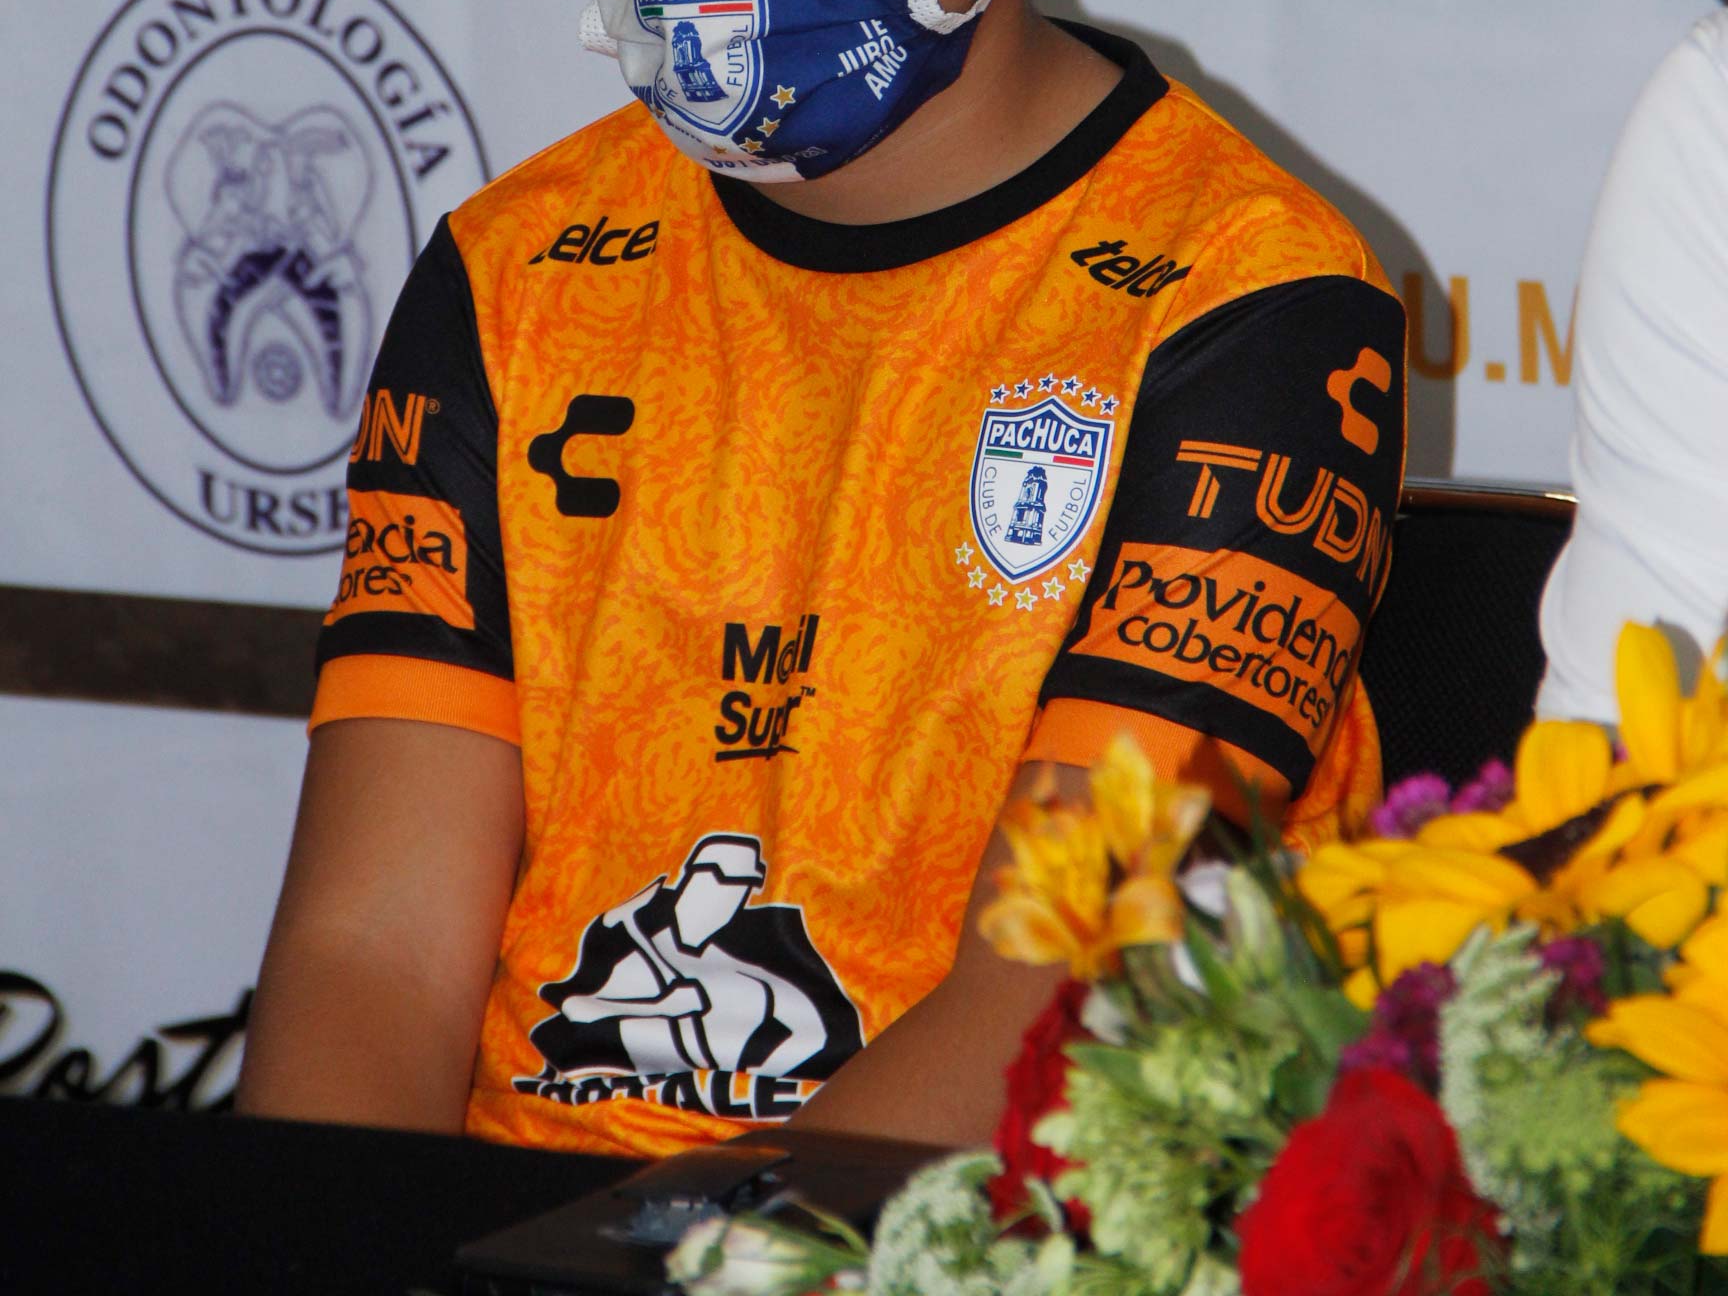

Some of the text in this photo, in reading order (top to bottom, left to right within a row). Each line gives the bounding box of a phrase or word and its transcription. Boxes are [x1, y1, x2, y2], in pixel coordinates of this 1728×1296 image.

[528, 216, 660, 266] elce
[989, 417, 1093, 456] PACHUCA
[982, 466, 1002, 538] CLUB DE
[1048, 478, 1087, 542] FUTBOL
[1176, 440, 1388, 596] TUDN
[1118, 615, 1330, 728] cobertores
